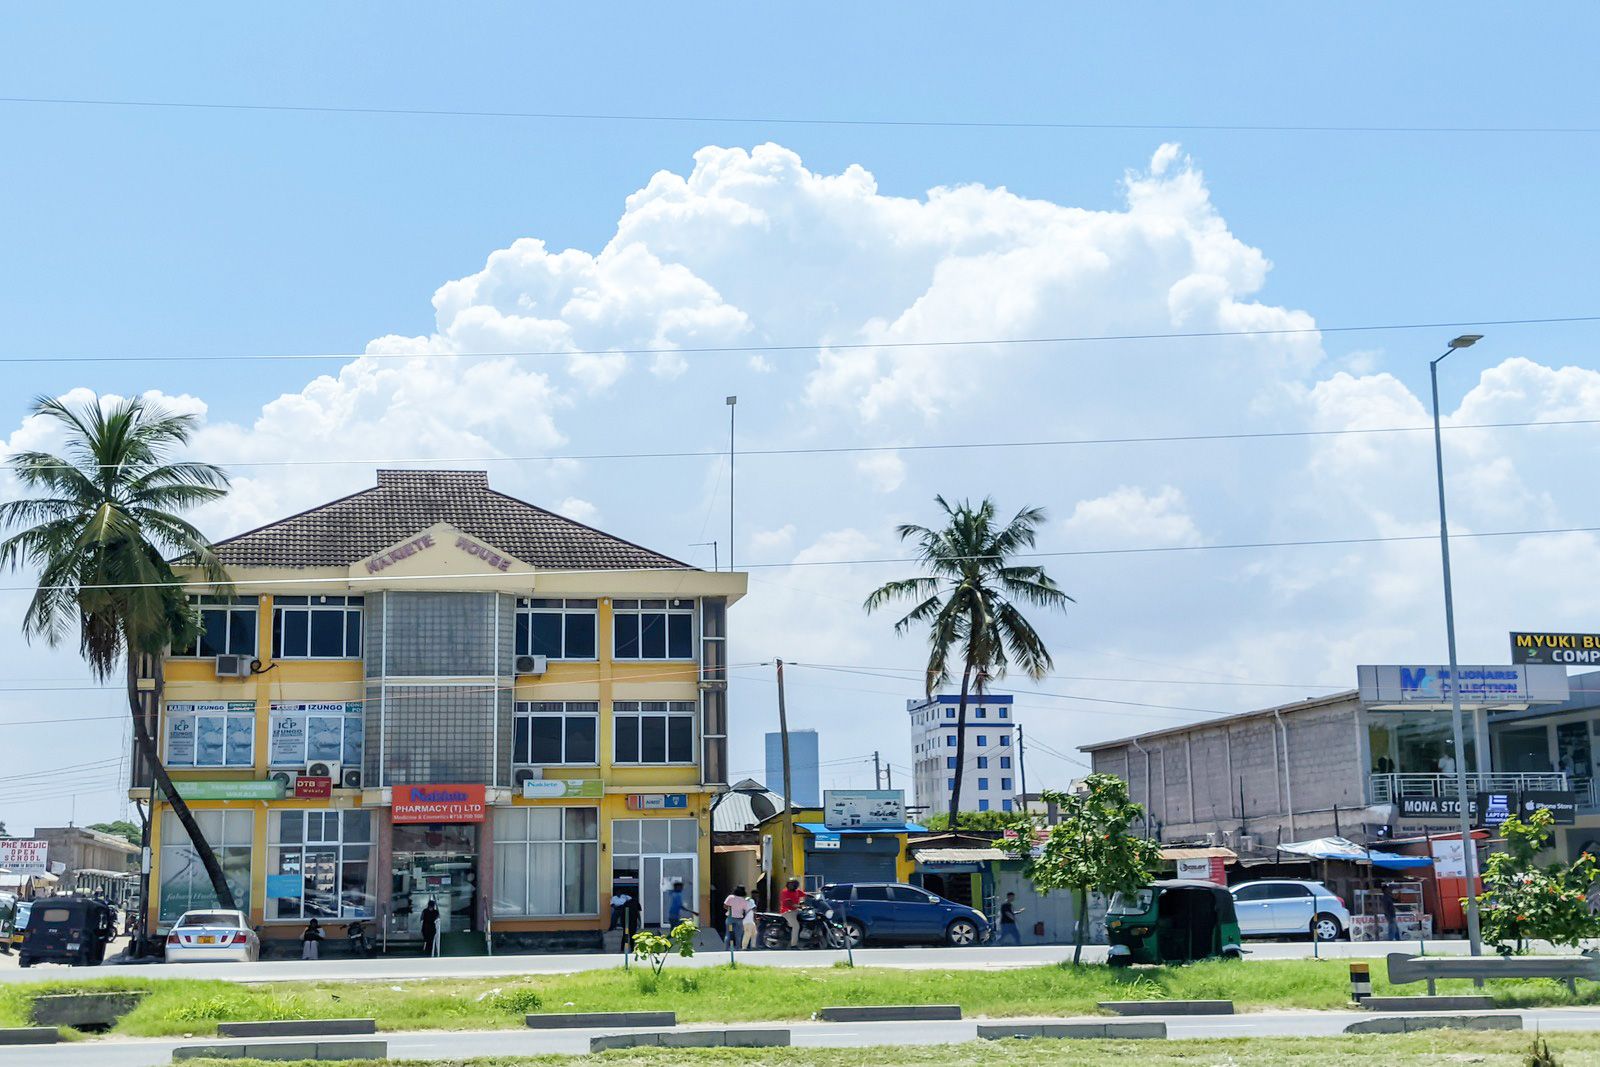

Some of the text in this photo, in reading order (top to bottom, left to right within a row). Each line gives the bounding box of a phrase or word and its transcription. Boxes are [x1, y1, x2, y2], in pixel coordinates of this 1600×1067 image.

[455, 537, 512, 572] HOUSE
[1516, 635, 1577, 648] MYUKI
[1552, 650, 1600, 662] COMP
[395, 804, 481, 813] PHARMACY (T) LTD
[1404, 800, 1477, 812] MONA STOE
